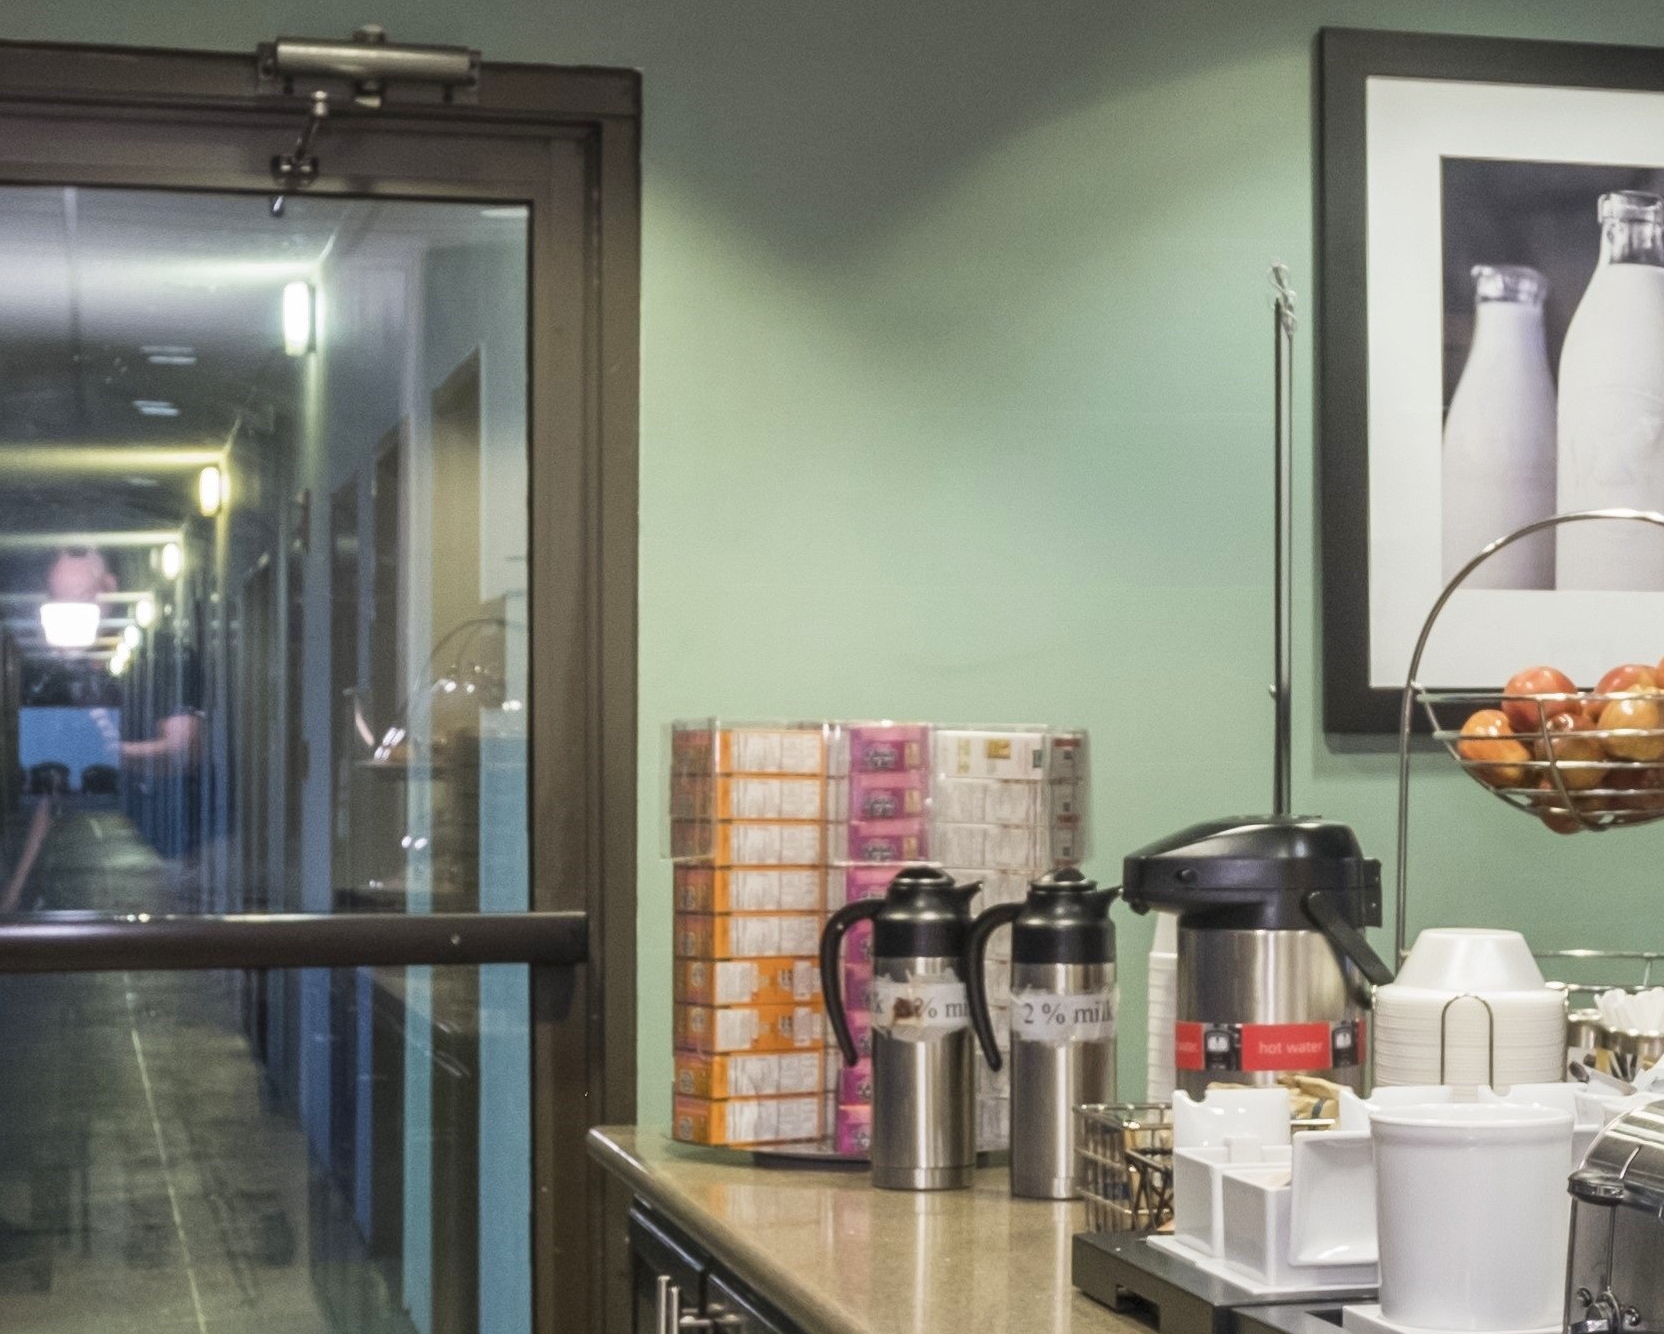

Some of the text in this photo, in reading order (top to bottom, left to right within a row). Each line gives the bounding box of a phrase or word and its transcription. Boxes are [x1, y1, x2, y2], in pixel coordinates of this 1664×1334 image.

[1074, 999, 1114, 1025] milk
[1258, 1041, 1323, 1055] hot water
